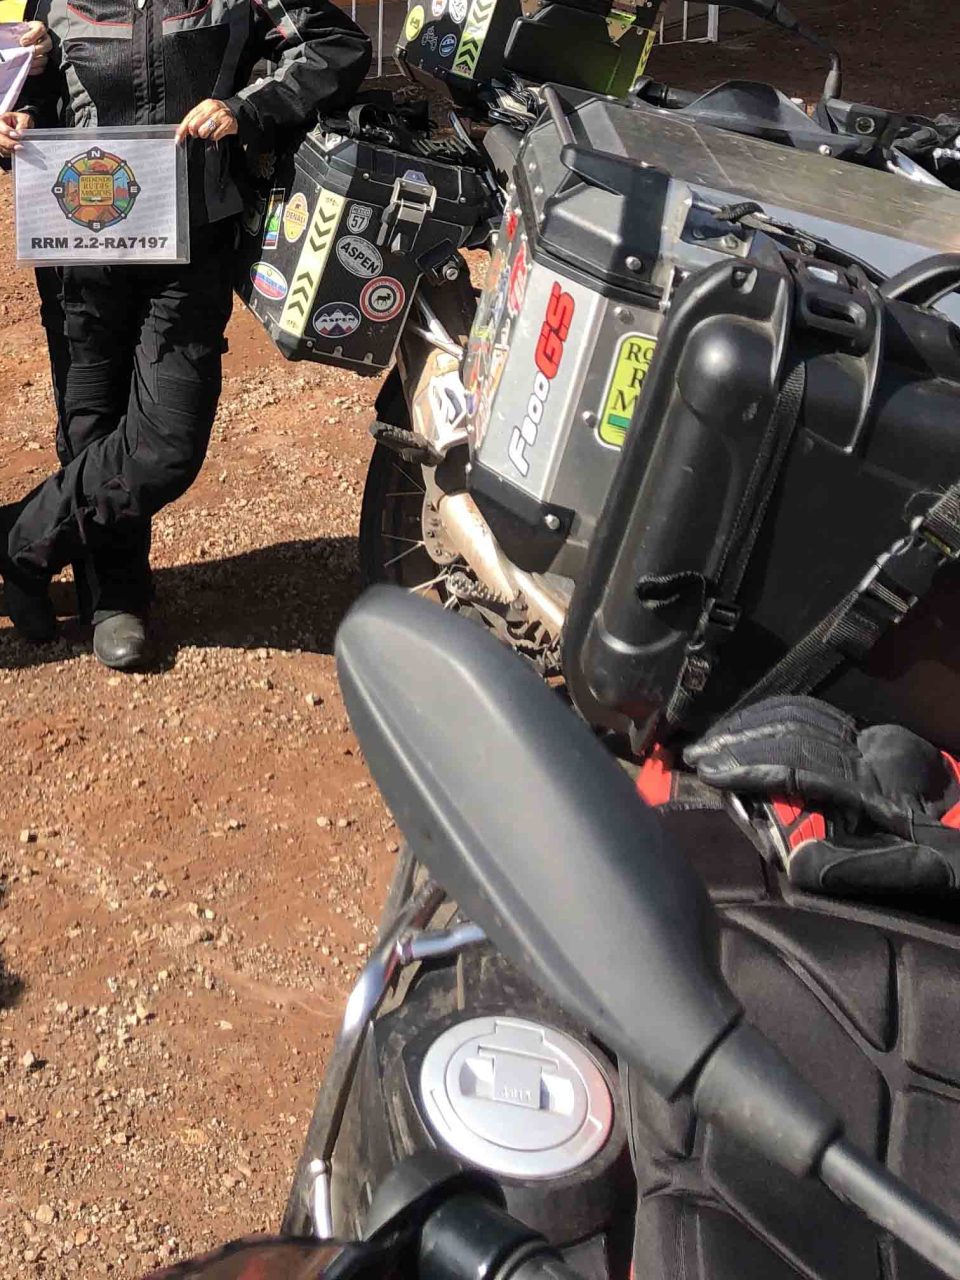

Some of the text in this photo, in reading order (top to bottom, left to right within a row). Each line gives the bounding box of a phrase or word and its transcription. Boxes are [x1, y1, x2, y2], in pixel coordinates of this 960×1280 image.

[91, 150, 101, 158] N
[351, 215, 365, 229] 57
[31, 237, 169, 249] RRM 2.2-RA7197
[340, 242, 379, 274] ASPEN
